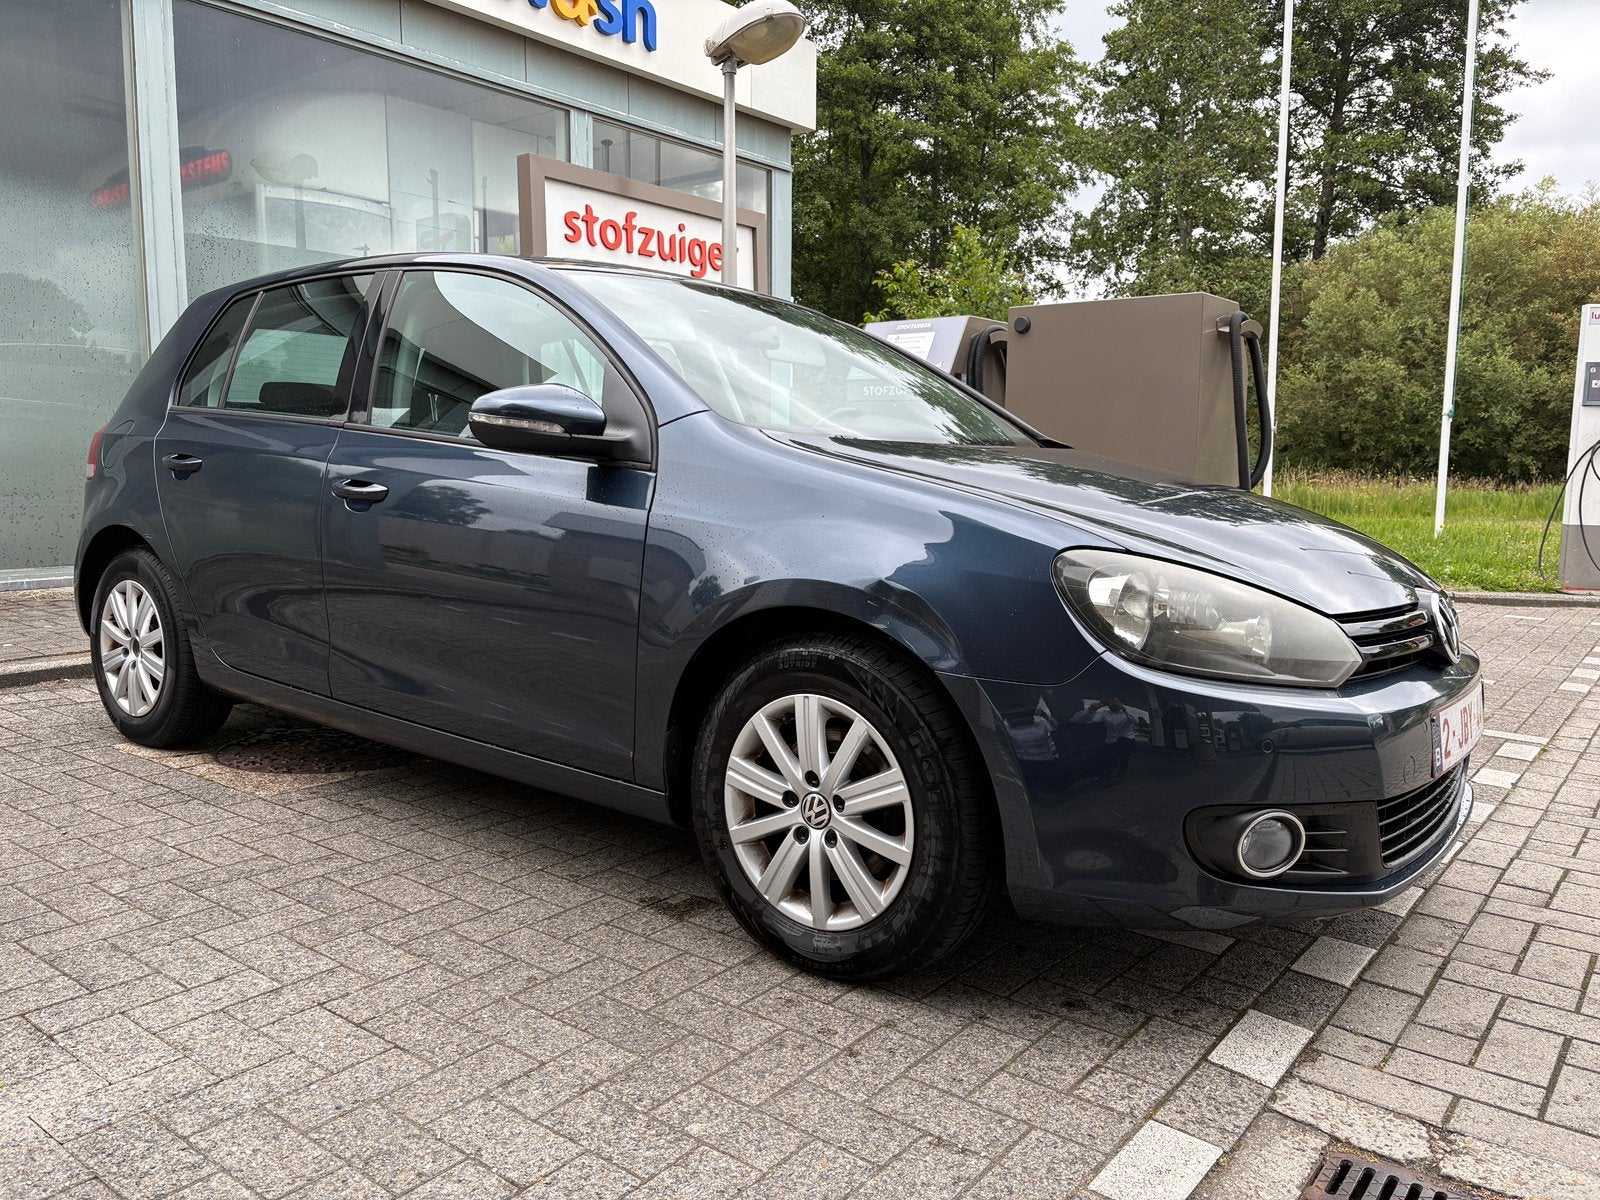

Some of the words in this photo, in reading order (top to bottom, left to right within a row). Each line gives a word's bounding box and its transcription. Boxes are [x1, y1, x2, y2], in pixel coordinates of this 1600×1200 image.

[527, 0, 657, 52] ash
[563, 203, 740, 278] stofzuige
[863, 386, 906, 396] STOFZU
